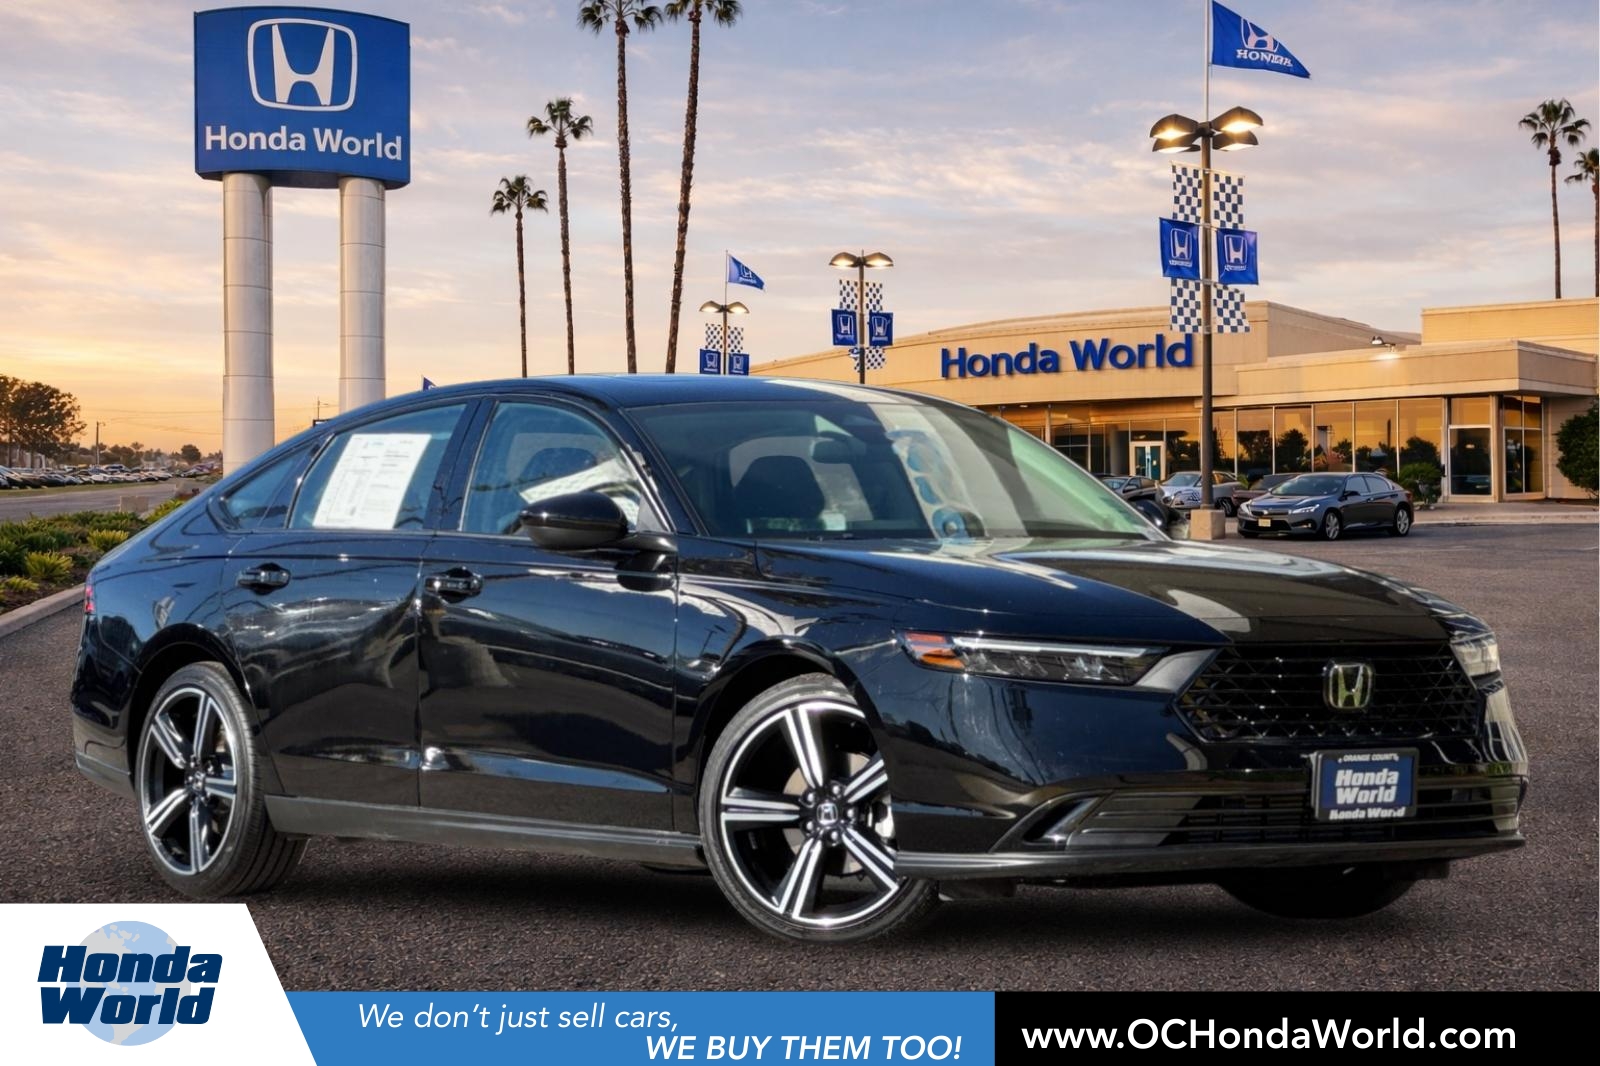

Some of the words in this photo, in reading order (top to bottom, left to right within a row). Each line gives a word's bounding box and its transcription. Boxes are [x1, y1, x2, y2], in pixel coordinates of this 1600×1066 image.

[205, 125, 306, 151] Honda
[312, 127, 403, 161] World
[941, 342, 1061, 378] Honda
[1069, 333, 1195, 371] World
[1335, 768, 1400, 787] Honda
[1336, 786, 1398, 805] World
[1329, 808, 1367, 821] Honda
